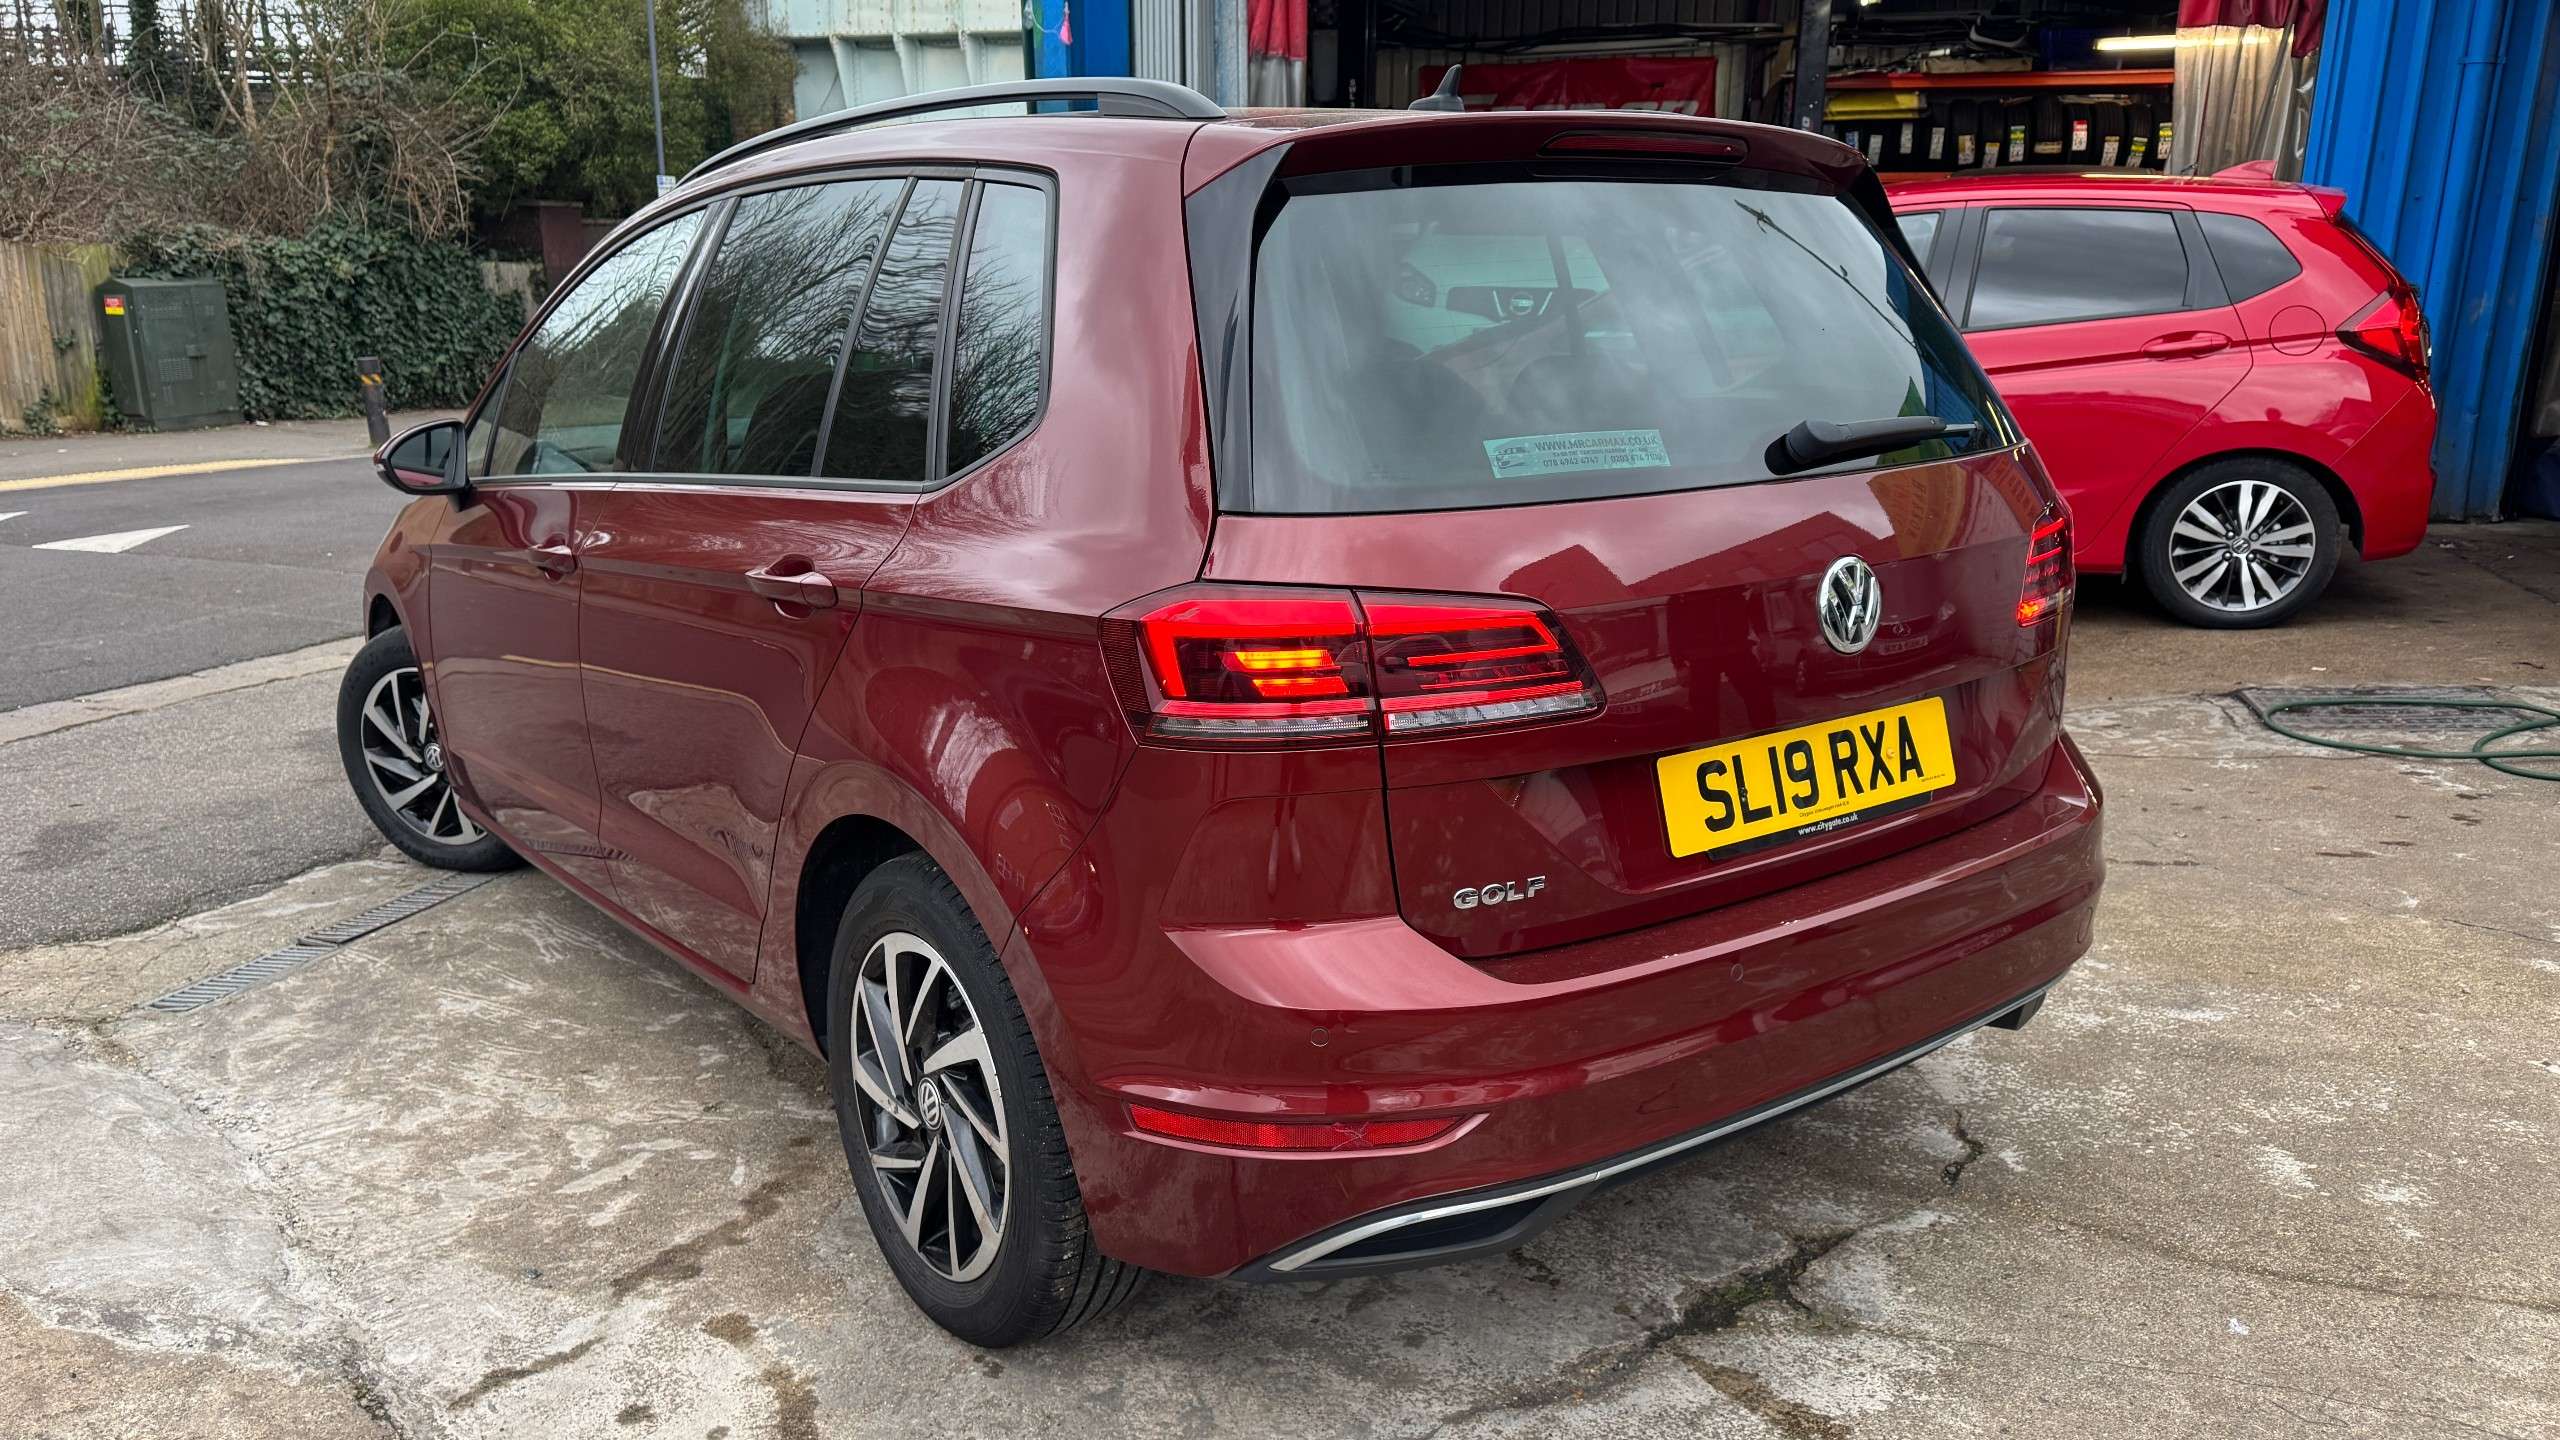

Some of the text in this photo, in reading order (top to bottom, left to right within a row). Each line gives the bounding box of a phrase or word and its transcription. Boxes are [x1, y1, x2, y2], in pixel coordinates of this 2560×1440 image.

[1696, 715, 1924, 833] SL19 RXA
[1798, 813, 1859, 836] www.citygate.co.uk
[1453, 875, 1546, 909] GOLF
